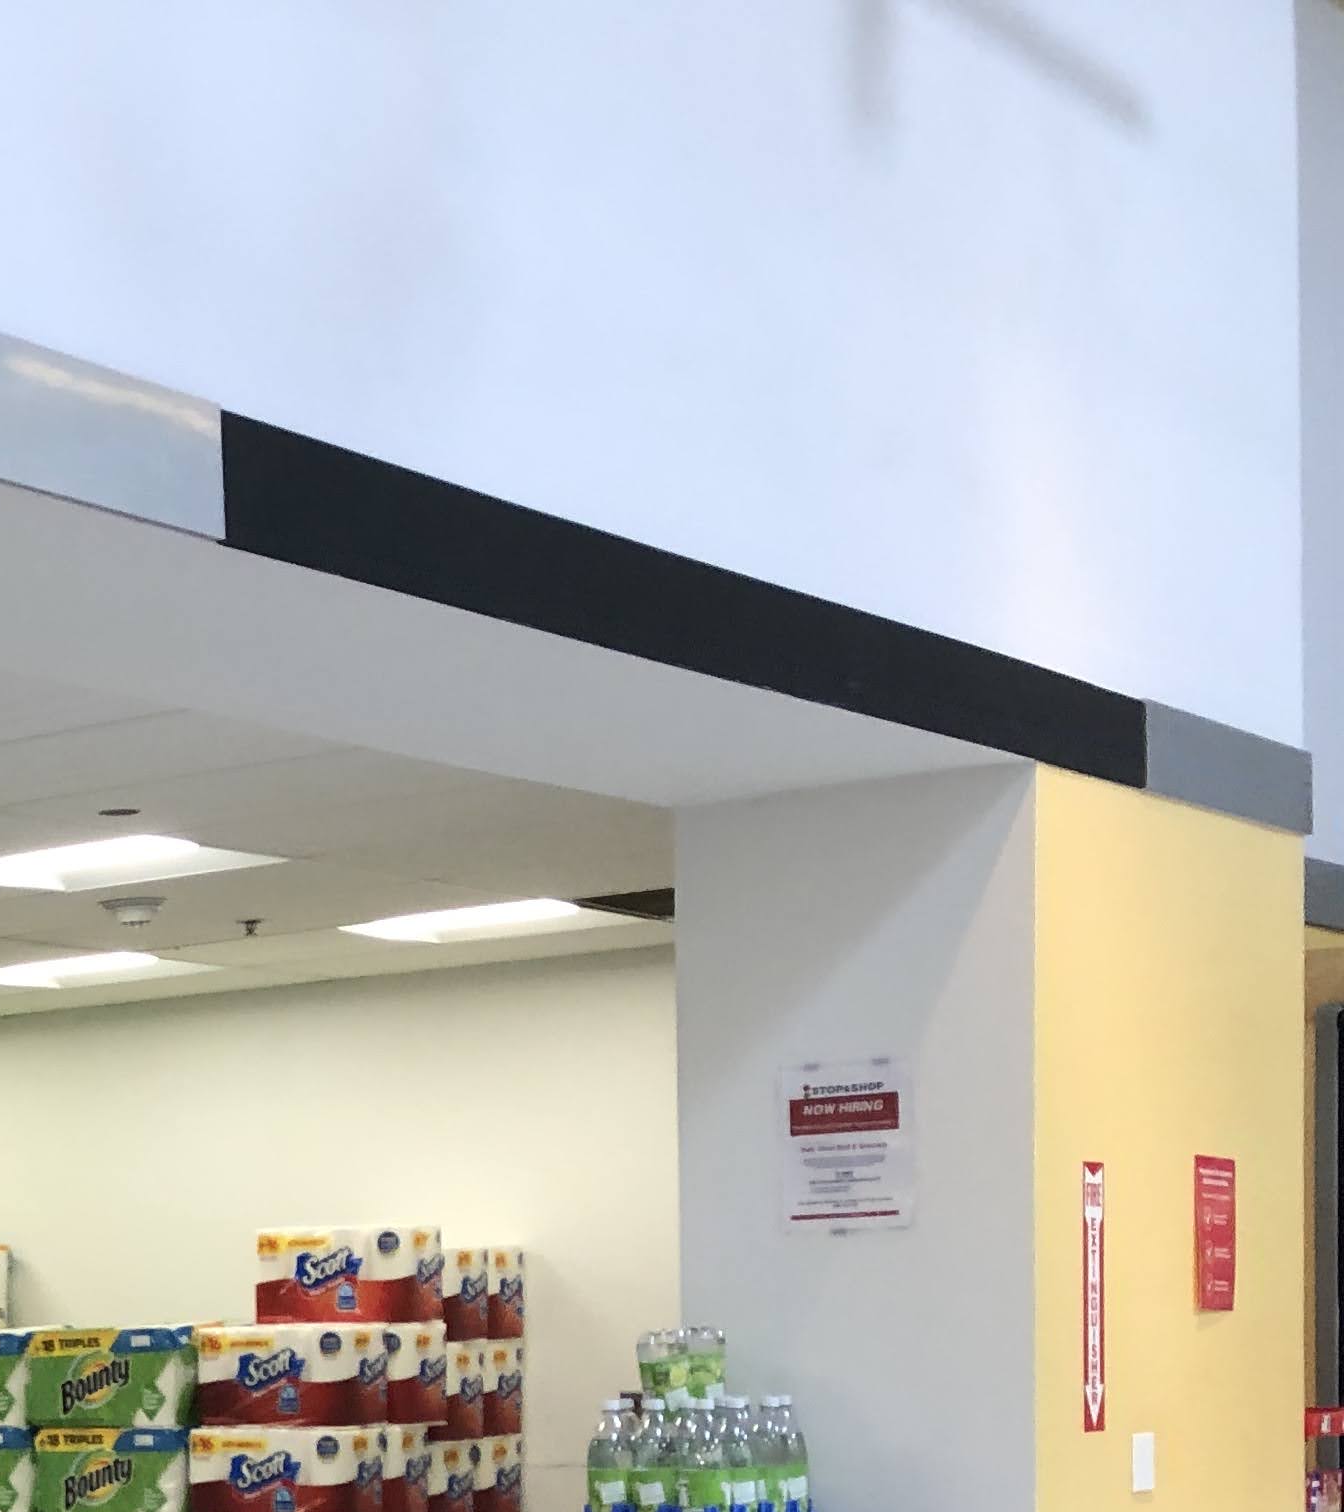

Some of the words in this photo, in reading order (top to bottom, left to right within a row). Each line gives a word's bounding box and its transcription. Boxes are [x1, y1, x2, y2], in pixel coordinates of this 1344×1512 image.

[803, 1102, 835, 1116] NOW
[839, 1099, 884, 1114] HIRING
[58, 1337, 101, 1349] TRIPLES
[61, 1358, 130, 1416] Bounty
[240, 1349, 293, 1387] Scott
[63, 1434, 105, 1446] TRIPLES
[64, 1458, 133, 1511] Bounty
[236, 1451, 287, 1489] Scott
